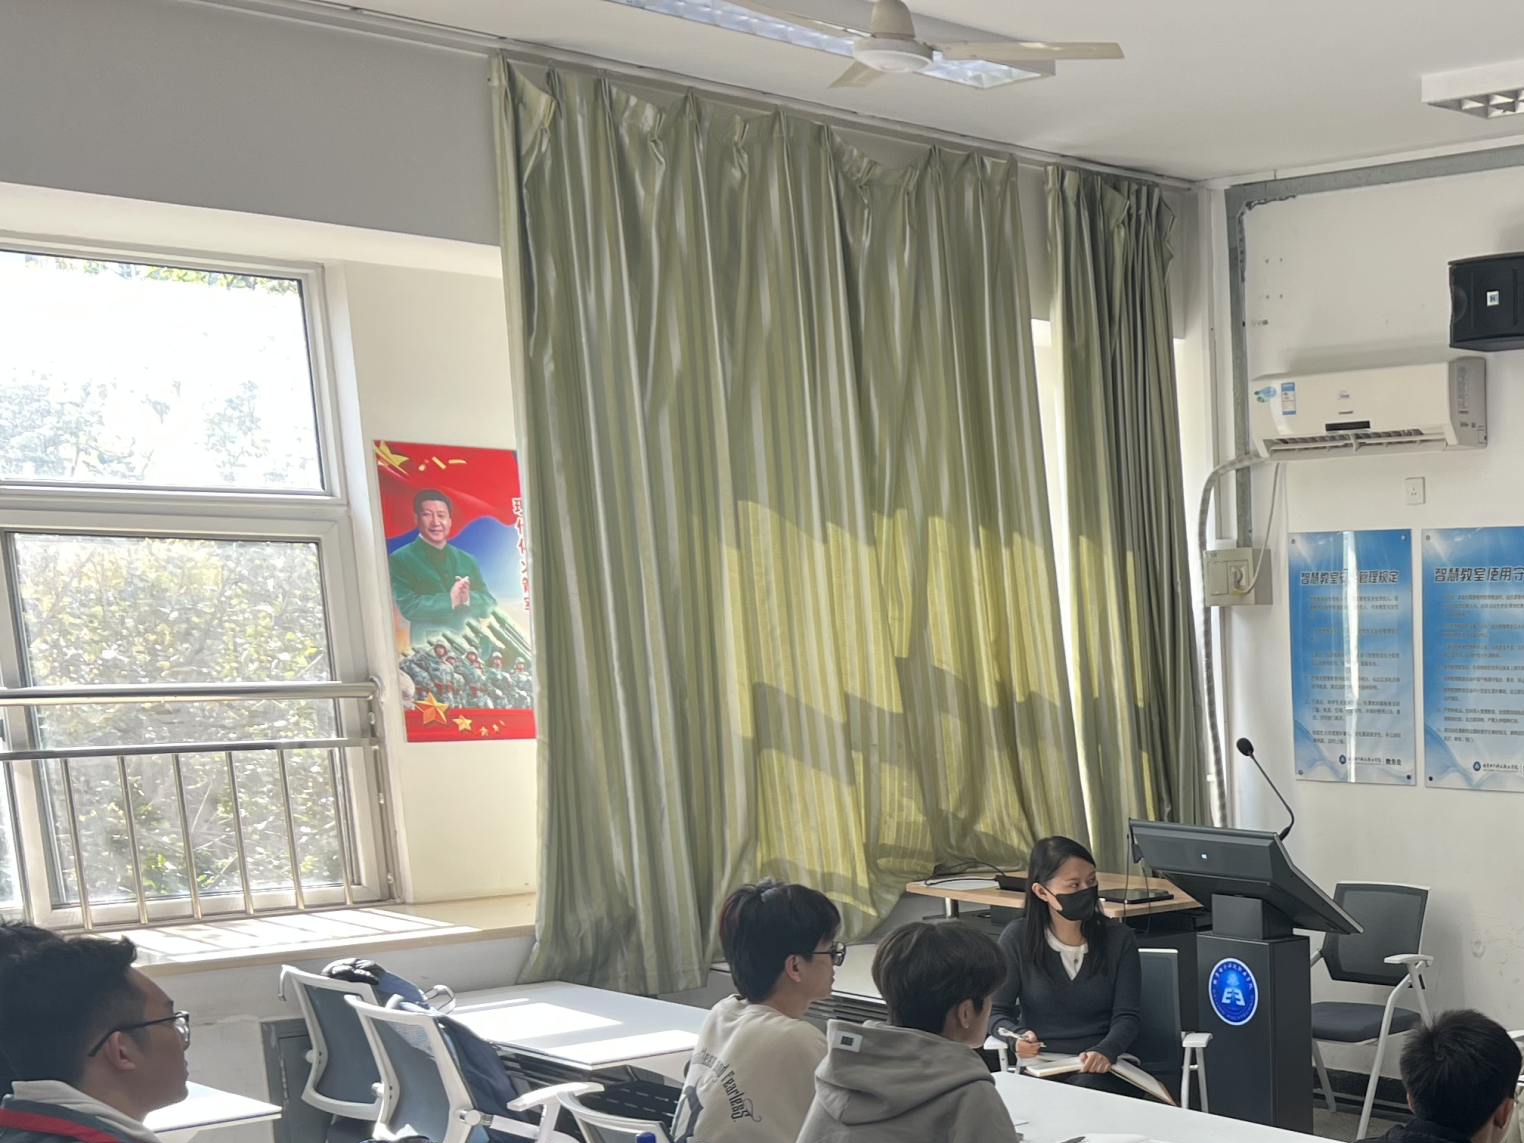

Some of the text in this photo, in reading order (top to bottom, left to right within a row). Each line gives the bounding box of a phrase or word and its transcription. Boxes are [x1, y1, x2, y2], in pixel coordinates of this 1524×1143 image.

[1301, 569, 1398, 585] 智慧教室安管理规定
